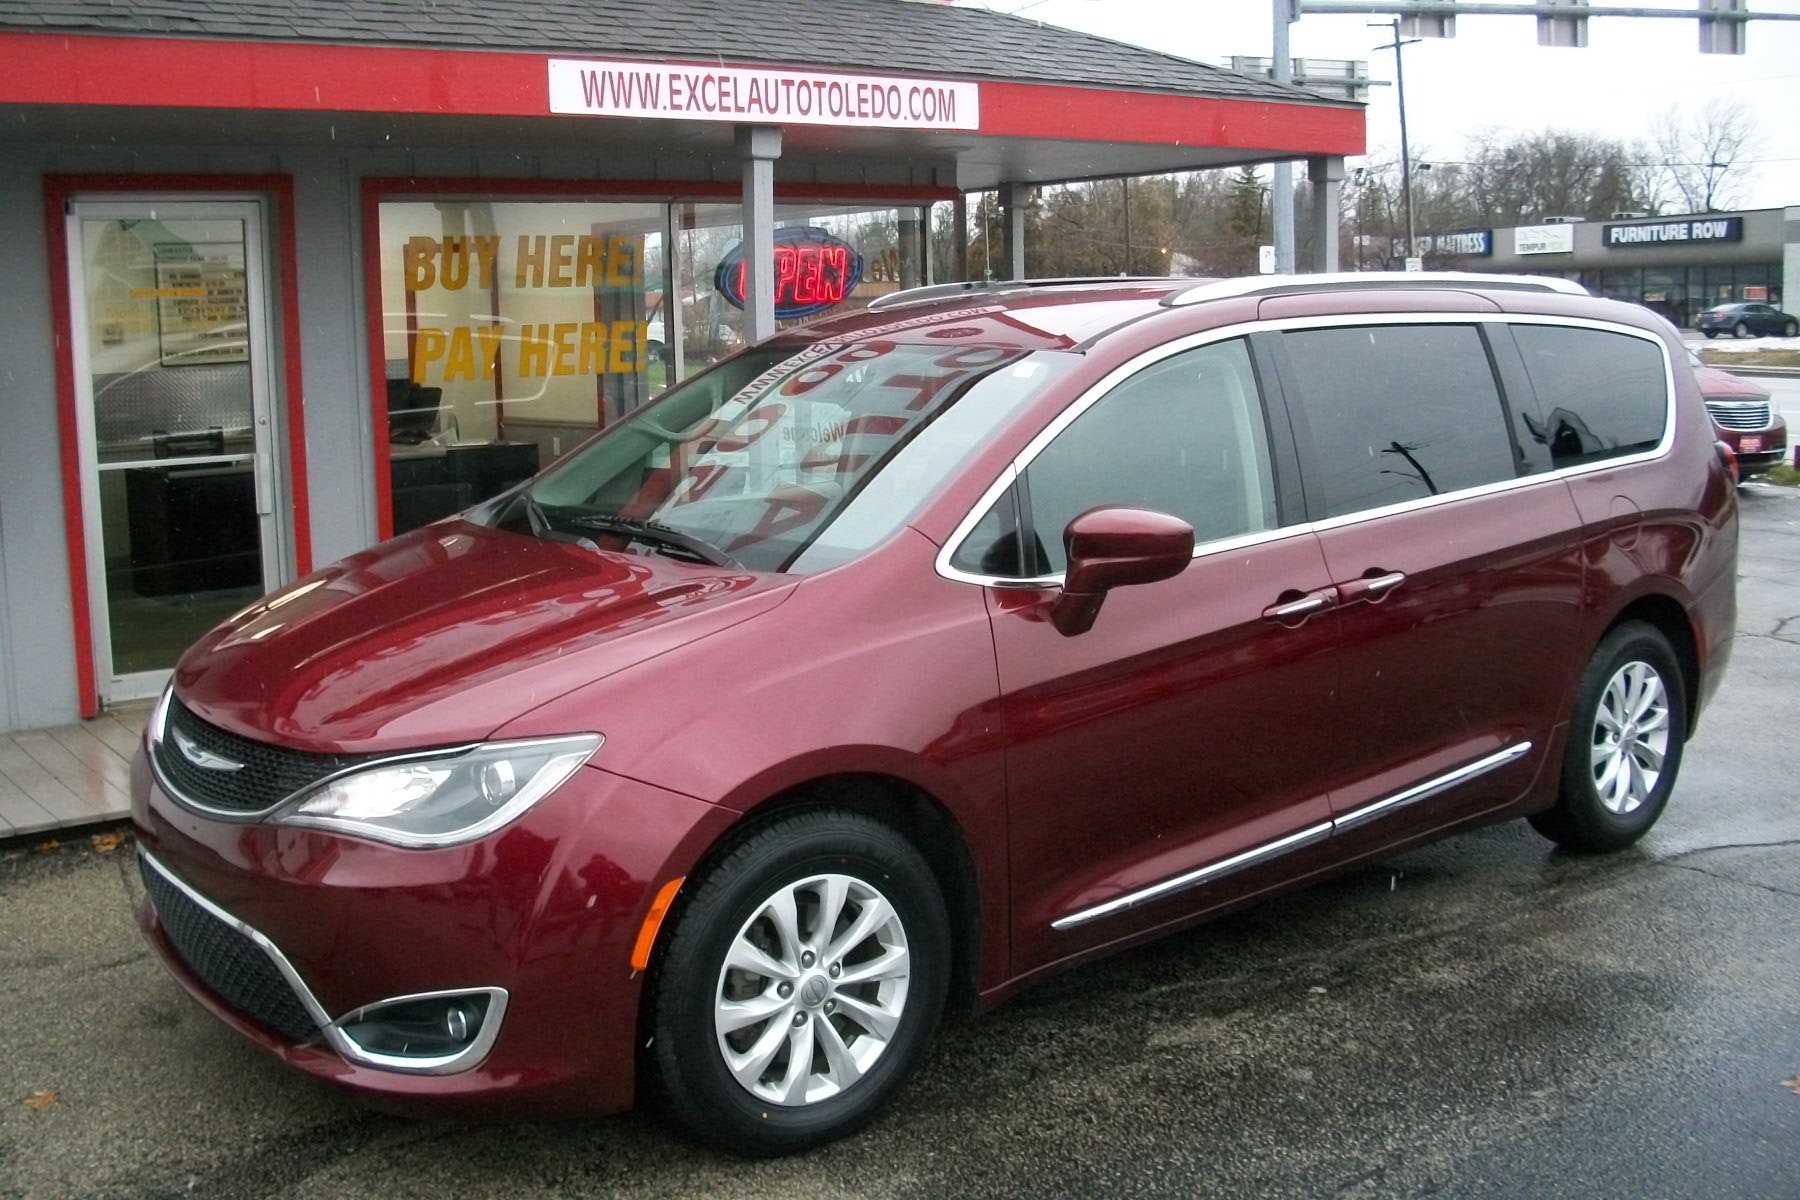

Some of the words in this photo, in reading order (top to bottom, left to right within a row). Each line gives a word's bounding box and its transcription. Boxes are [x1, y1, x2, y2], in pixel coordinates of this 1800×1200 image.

[580, 69, 957, 122] WWW.EXCELAUTOTOLEDO.COM
[1611, 224, 1689, 243] FURNITURE
[1692, 221, 1728, 239] ROW
[405, 235, 502, 291] BUY
[515, 234, 646, 289] HERE!
[738, 246, 848, 304] PEN
[413, 325, 505, 384] PAY
[518, 320, 647, 378] HERE!
